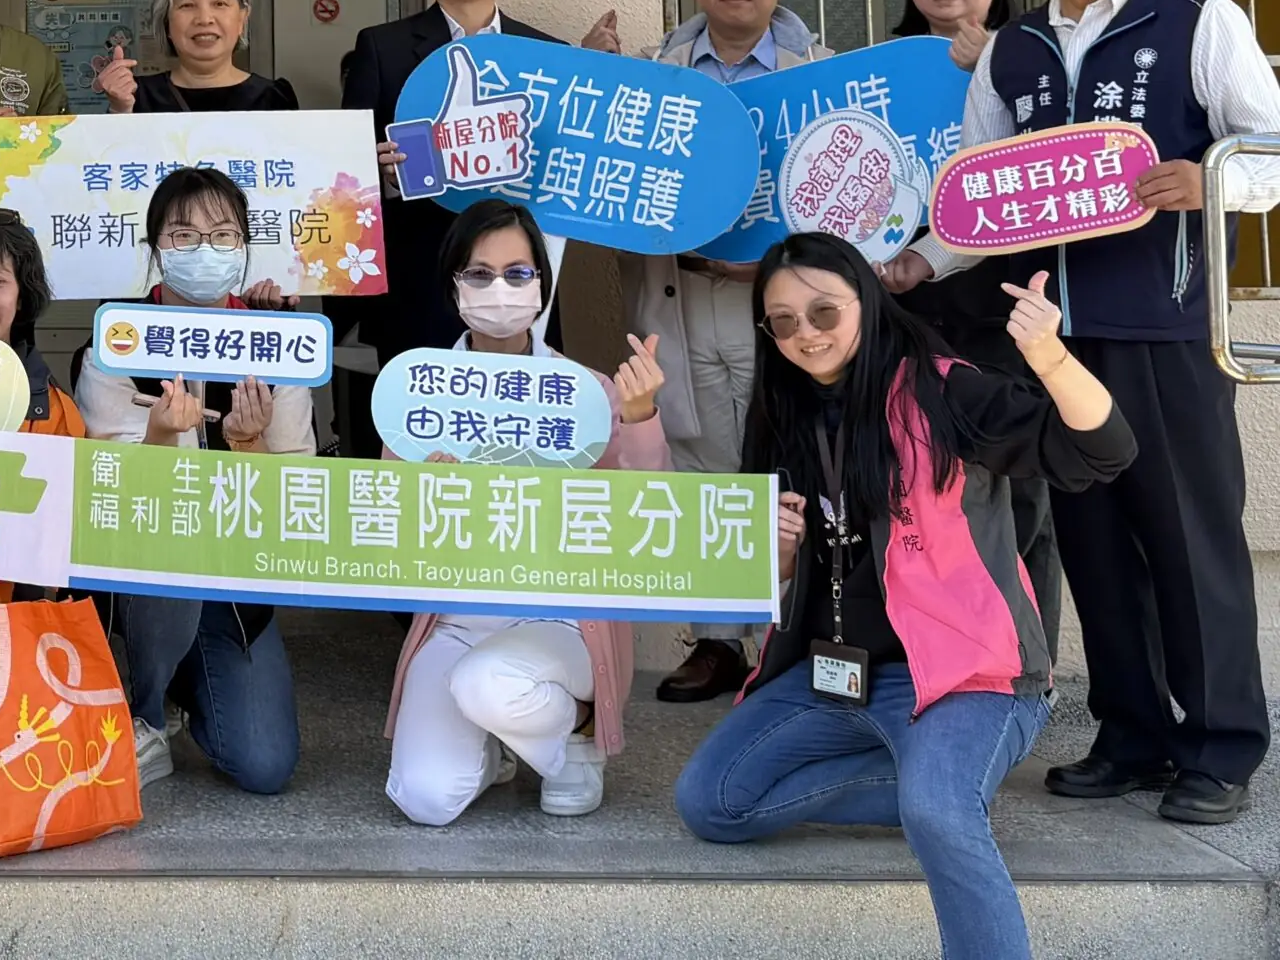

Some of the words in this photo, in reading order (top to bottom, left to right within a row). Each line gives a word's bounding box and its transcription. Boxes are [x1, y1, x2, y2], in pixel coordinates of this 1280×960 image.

[1037, 74, 1053, 107] 主任
[1130, 70, 1150, 127] 立法委
[433, 110, 521, 150] 新屋分院
[83, 159, 296, 192] 客家特醫院
[488, 141, 685, 232] 與照護
[791, 124, 862, 218] 我護理
[960, 147, 1124, 201] 健康百分百
[970, 181, 1133, 236] 人生才精彩
[144, 325, 317, 364] 覺得好開心
[408, 363, 576, 406] 您的健康
[406, 406, 576, 451] 由我守護
[91, 450, 202, 494] 衛生
[90, 492, 202, 537] 福利部
[208, 460, 755, 560] 桃園醫院新屋分院
[254, 552, 319, 575] Sinwu
[413, 560, 505, 587] Taoyuan
[510, 564, 597, 587] General
[603, 568, 693, 593] Hospital
